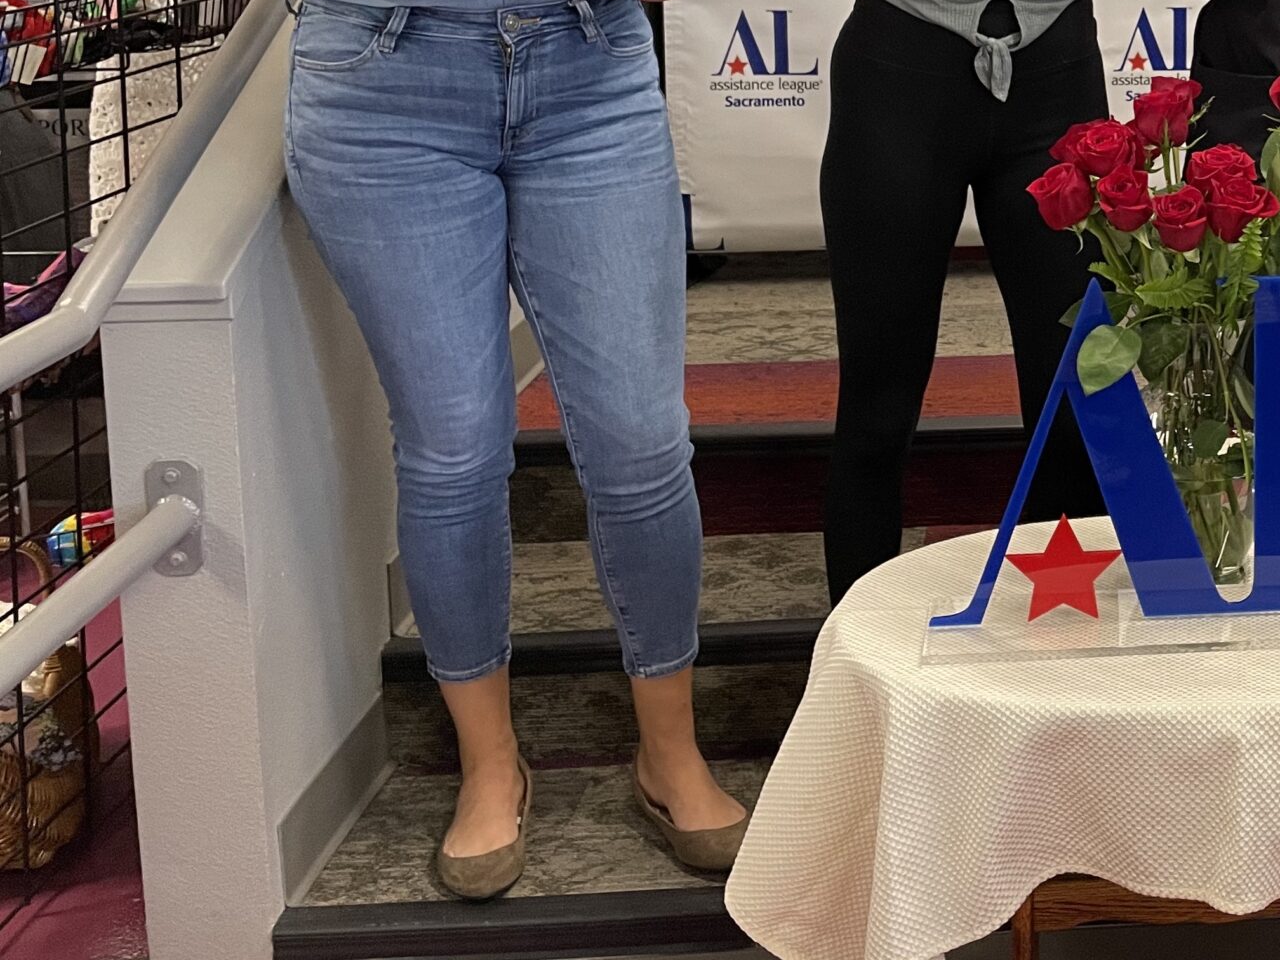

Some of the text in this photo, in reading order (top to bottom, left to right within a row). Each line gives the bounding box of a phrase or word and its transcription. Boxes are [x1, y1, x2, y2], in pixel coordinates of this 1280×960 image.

[711, 9, 819, 76] AL
[710, 77, 774, 92] assistance
[724, 95, 805, 109] Sacramento
